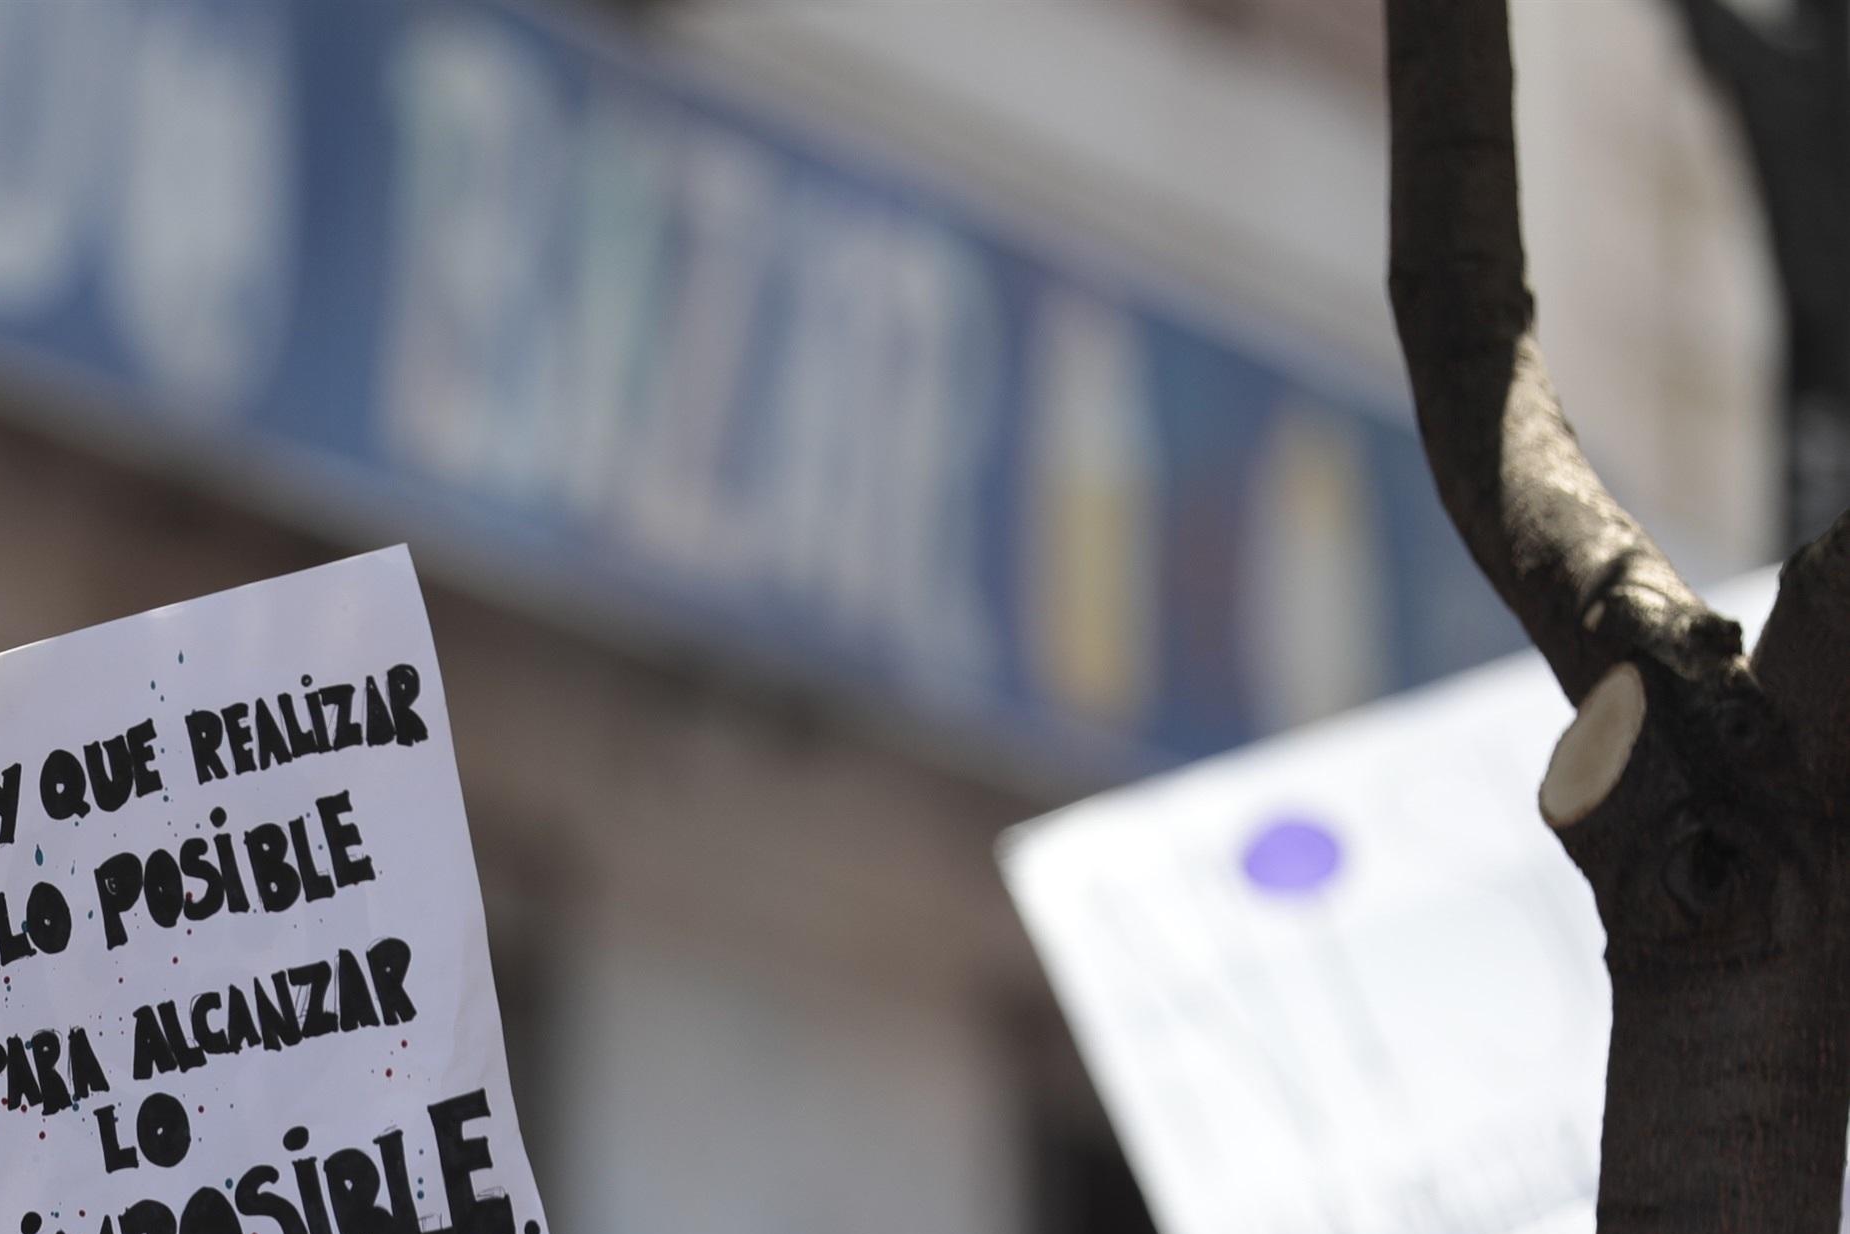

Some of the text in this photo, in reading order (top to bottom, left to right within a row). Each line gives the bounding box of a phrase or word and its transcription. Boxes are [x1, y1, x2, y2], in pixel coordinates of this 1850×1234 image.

[40, 719, 163, 820] QUE
[133, 938, 416, 1080] ALCANZAR
[93, 1093, 191, 1173] LO
